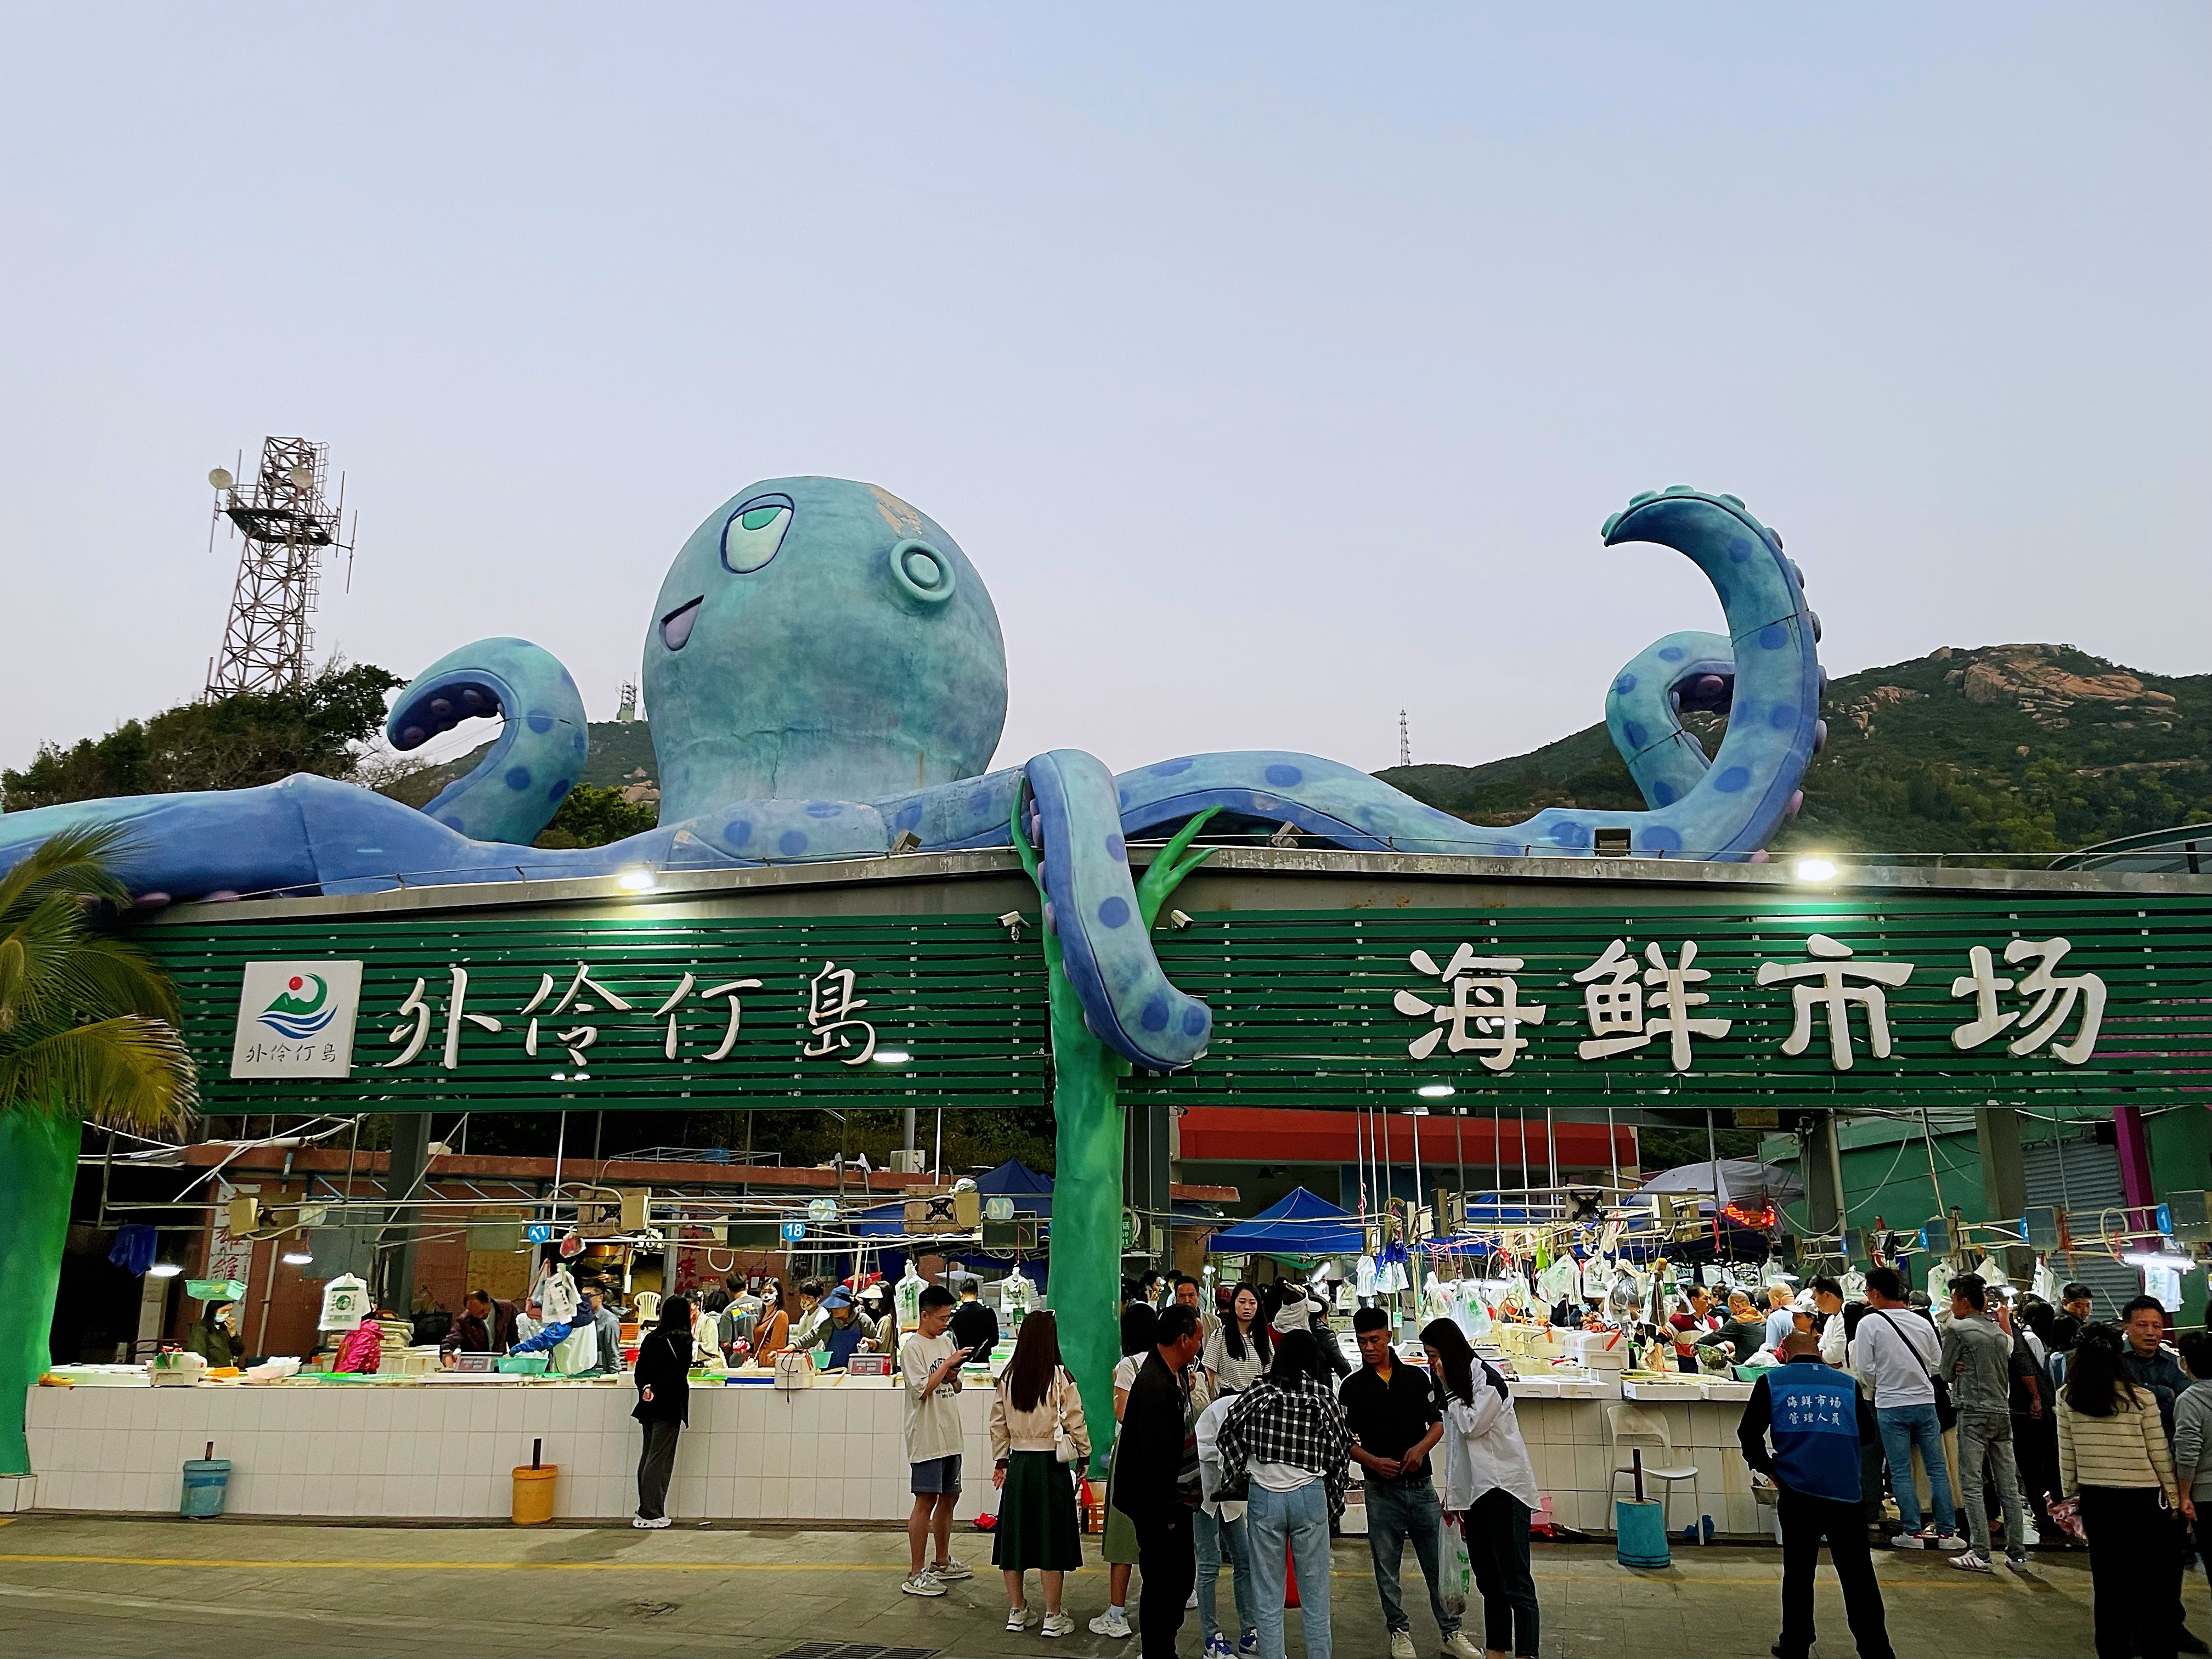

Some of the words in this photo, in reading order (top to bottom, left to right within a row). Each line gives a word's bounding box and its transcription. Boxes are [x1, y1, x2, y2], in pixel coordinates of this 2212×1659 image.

[1393, 933, 2107, 1071] 海鲜市场
[2161, 1211, 2168, 1228] 1
[531, 1226, 545, 1240] 17
[786, 1223, 802, 1237] 18
